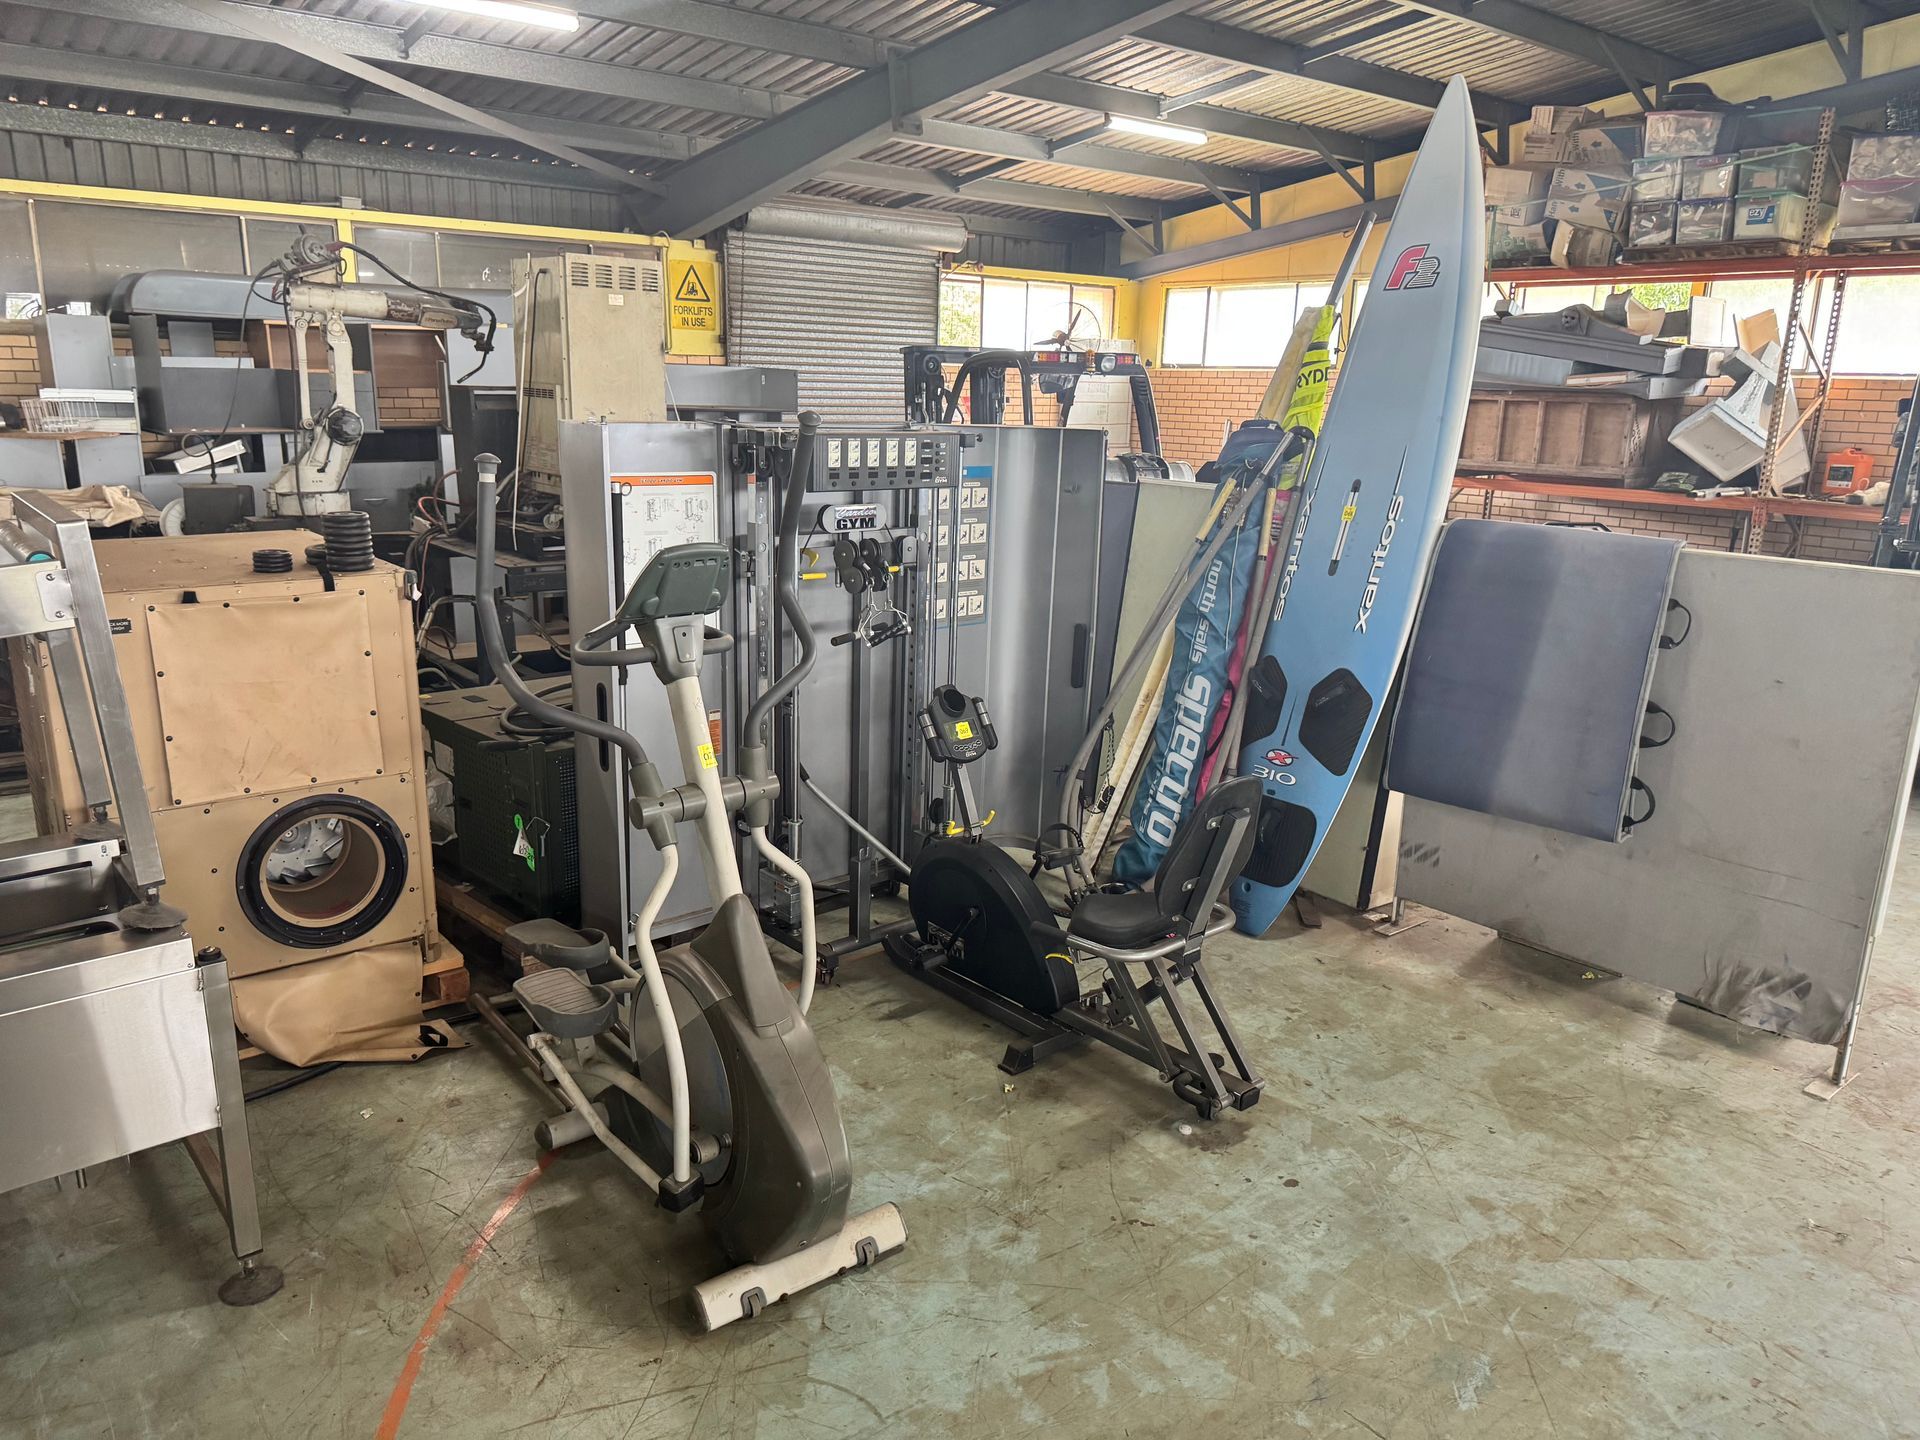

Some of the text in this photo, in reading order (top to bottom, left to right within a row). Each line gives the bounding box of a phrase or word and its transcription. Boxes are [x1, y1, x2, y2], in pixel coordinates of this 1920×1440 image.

[1750, 208, 1765, 217] ezy
[1383, 244, 1440, 290] F2
[674, 305, 713, 316] FORKLIFTS
[682, 317, 706, 327] IN USE
[836, 506, 877, 519] Cardio
[836, 517, 876, 529] GYM
[1274, 492, 1317, 621] xantos
[1353, 495, 1404, 634] xantos
[1199, 559, 1223, 614] north
[1192, 619, 1210, 663] sails
[1147, 674, 1211, 848] spectro
[1252, 764, 1297, 786] 310
